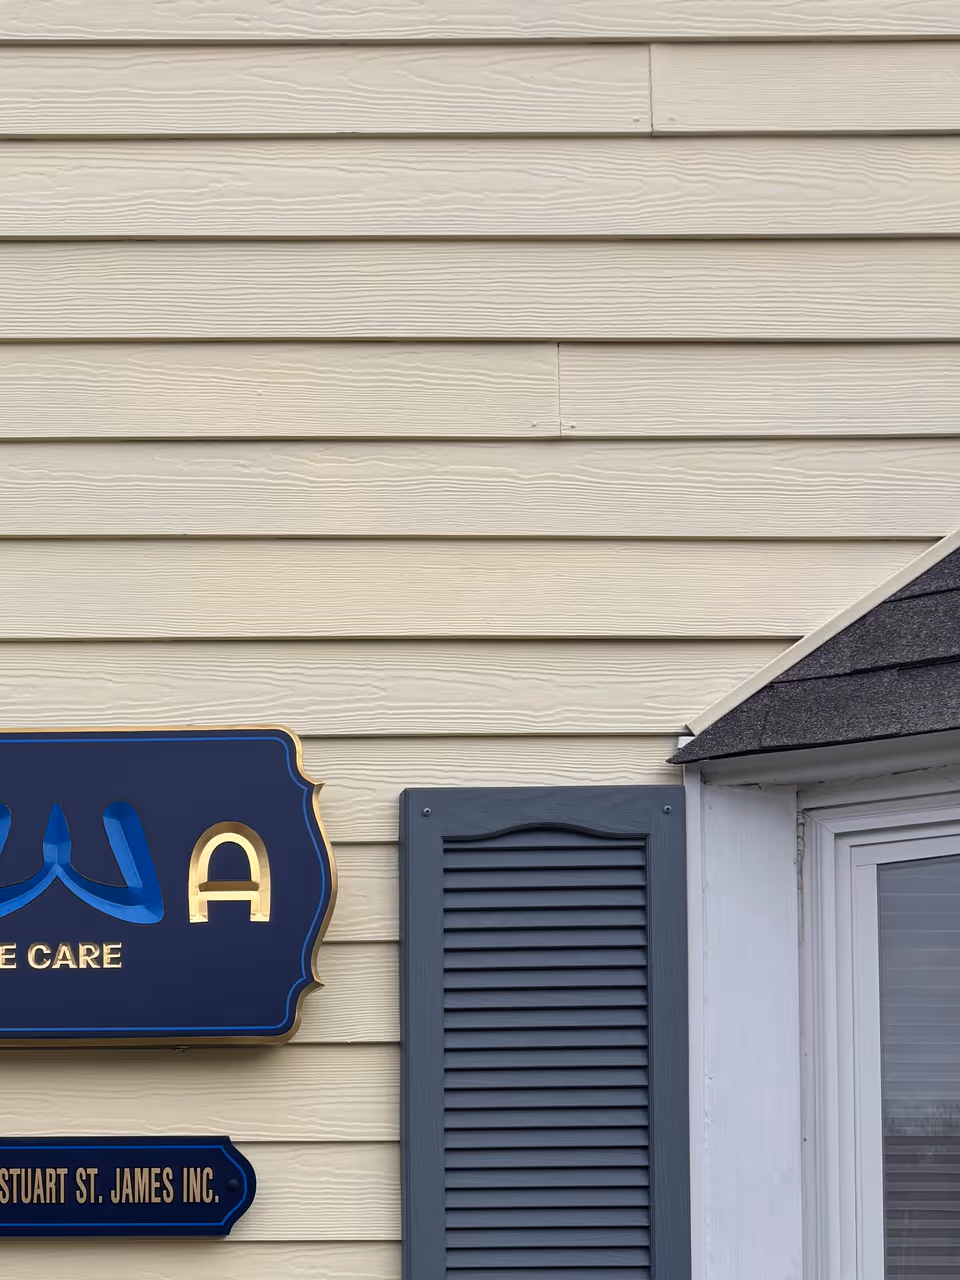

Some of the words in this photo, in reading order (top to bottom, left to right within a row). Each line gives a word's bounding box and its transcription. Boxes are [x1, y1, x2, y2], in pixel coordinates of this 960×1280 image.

[27, 942, 123, 970] CARE
[75, 1167, 103, 1204] ST.
[110, 1167, 174, 1204] JAMES
[183, 1167, 219, 1204] INC.
